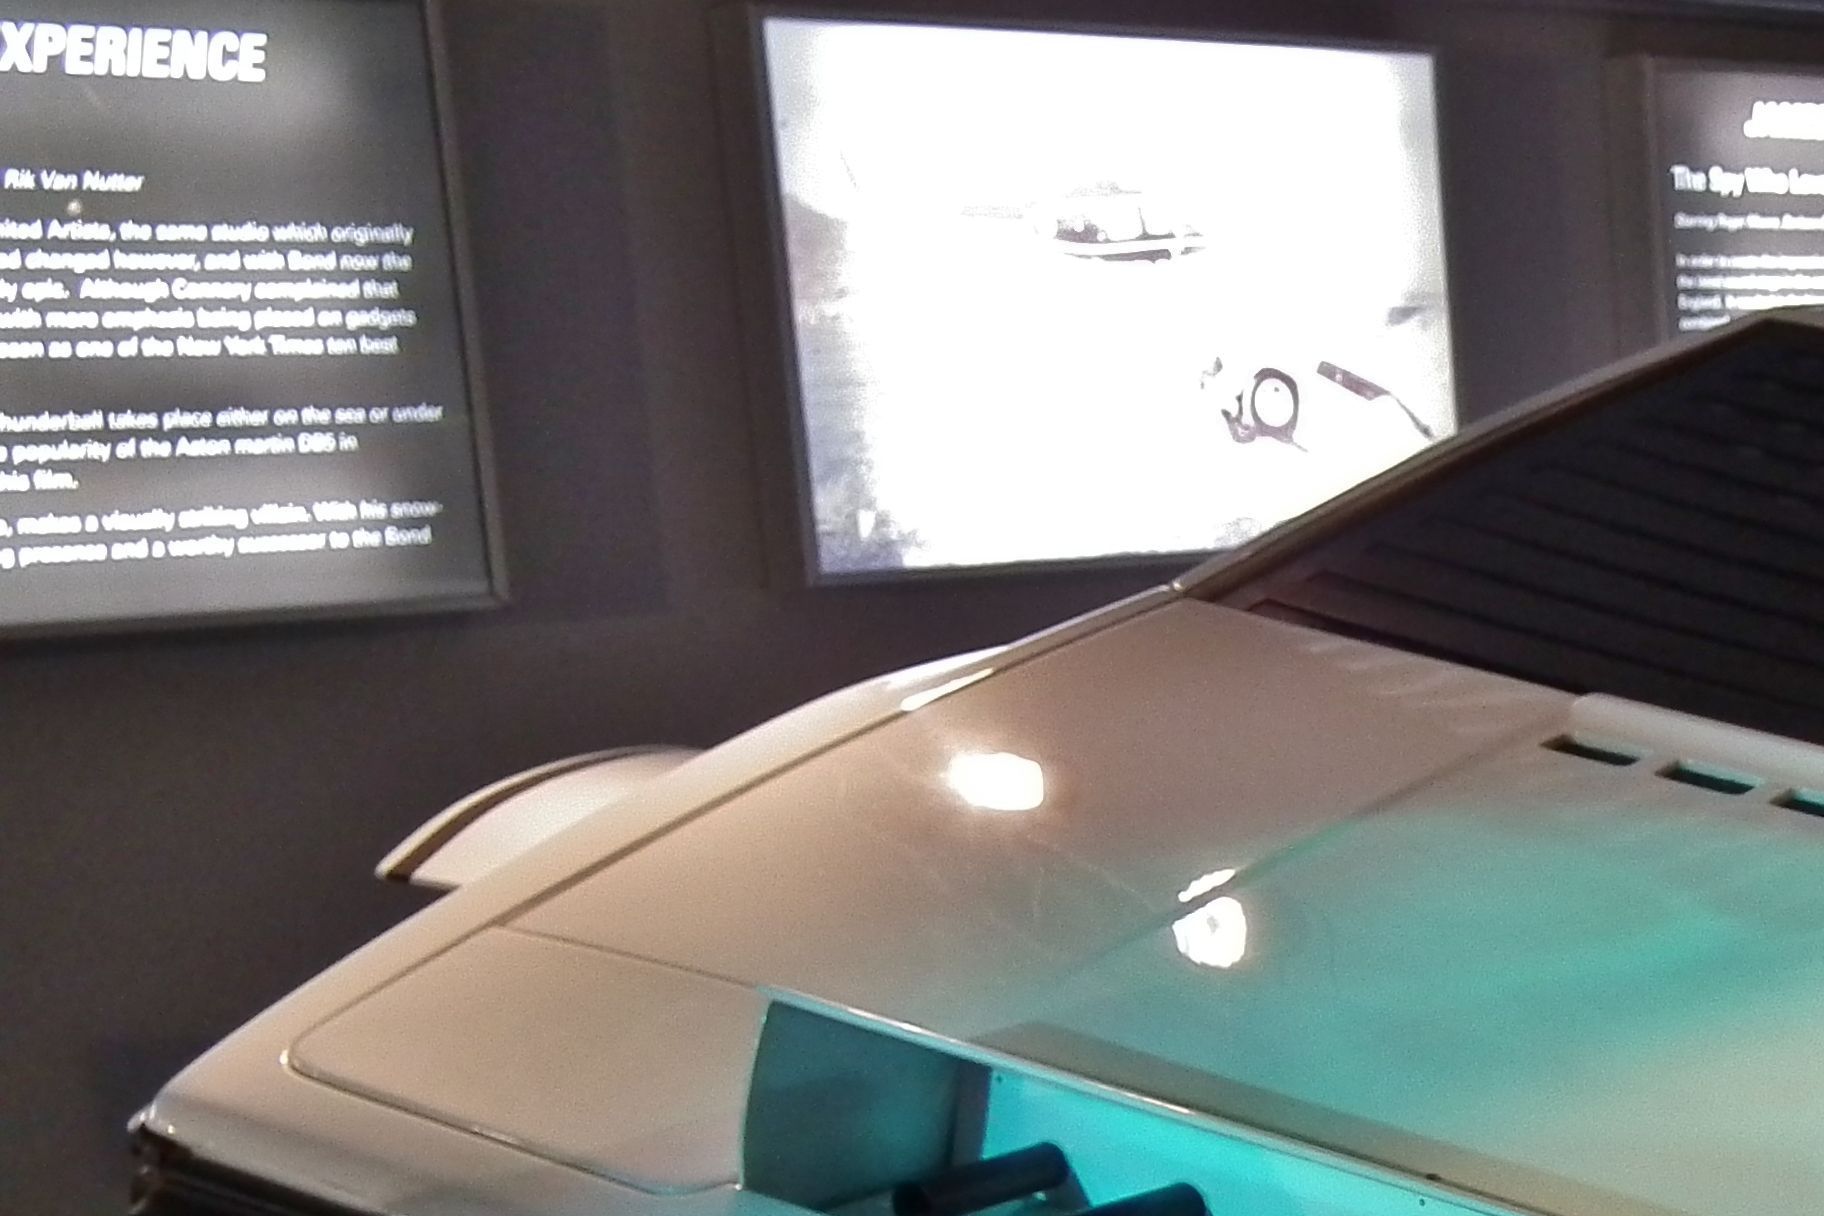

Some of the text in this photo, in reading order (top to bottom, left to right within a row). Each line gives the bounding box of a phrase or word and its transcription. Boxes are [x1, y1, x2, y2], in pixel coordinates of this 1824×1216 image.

[0, 21, 268, 82] XPERIENCE
[3, 168, 146, 192] Rik Van Nutter
[0, 218, 43, 240] ited
[118, 219, 152, 241] the
[271, 221, 329, 243] which
[330, 222, 414, 248] originally
[287, 249, 338, 271] Bond
[339, 254, 379, 271] now
[381, 251, 413, 271] the
[362, 278, 400, 299] that
[326, 336, 358, 355] ten
[359, 334, 400, 355] best
[107, 409, 159, 430] takes
[162, 408, 213, 432] place
[216, 406, 270, 428] either
[273, 408, 299, 426] on
[300, 405, 332, 426] the
[334, 407, 367, 425] sea
[369, 407, 389, 423] or
[391, 403, 444, 423] under
[11, 438, 112, 466] popularity
[115, 437, 137, 459] of
[139, 437, 172, 459] the
[175, 435, 232, 457] Aston
[338, 431, 359, 451] in
[359, 500, 388, 520] his
[351, 528, 382, 548] the
[384, 525, 433, 547] Bond
